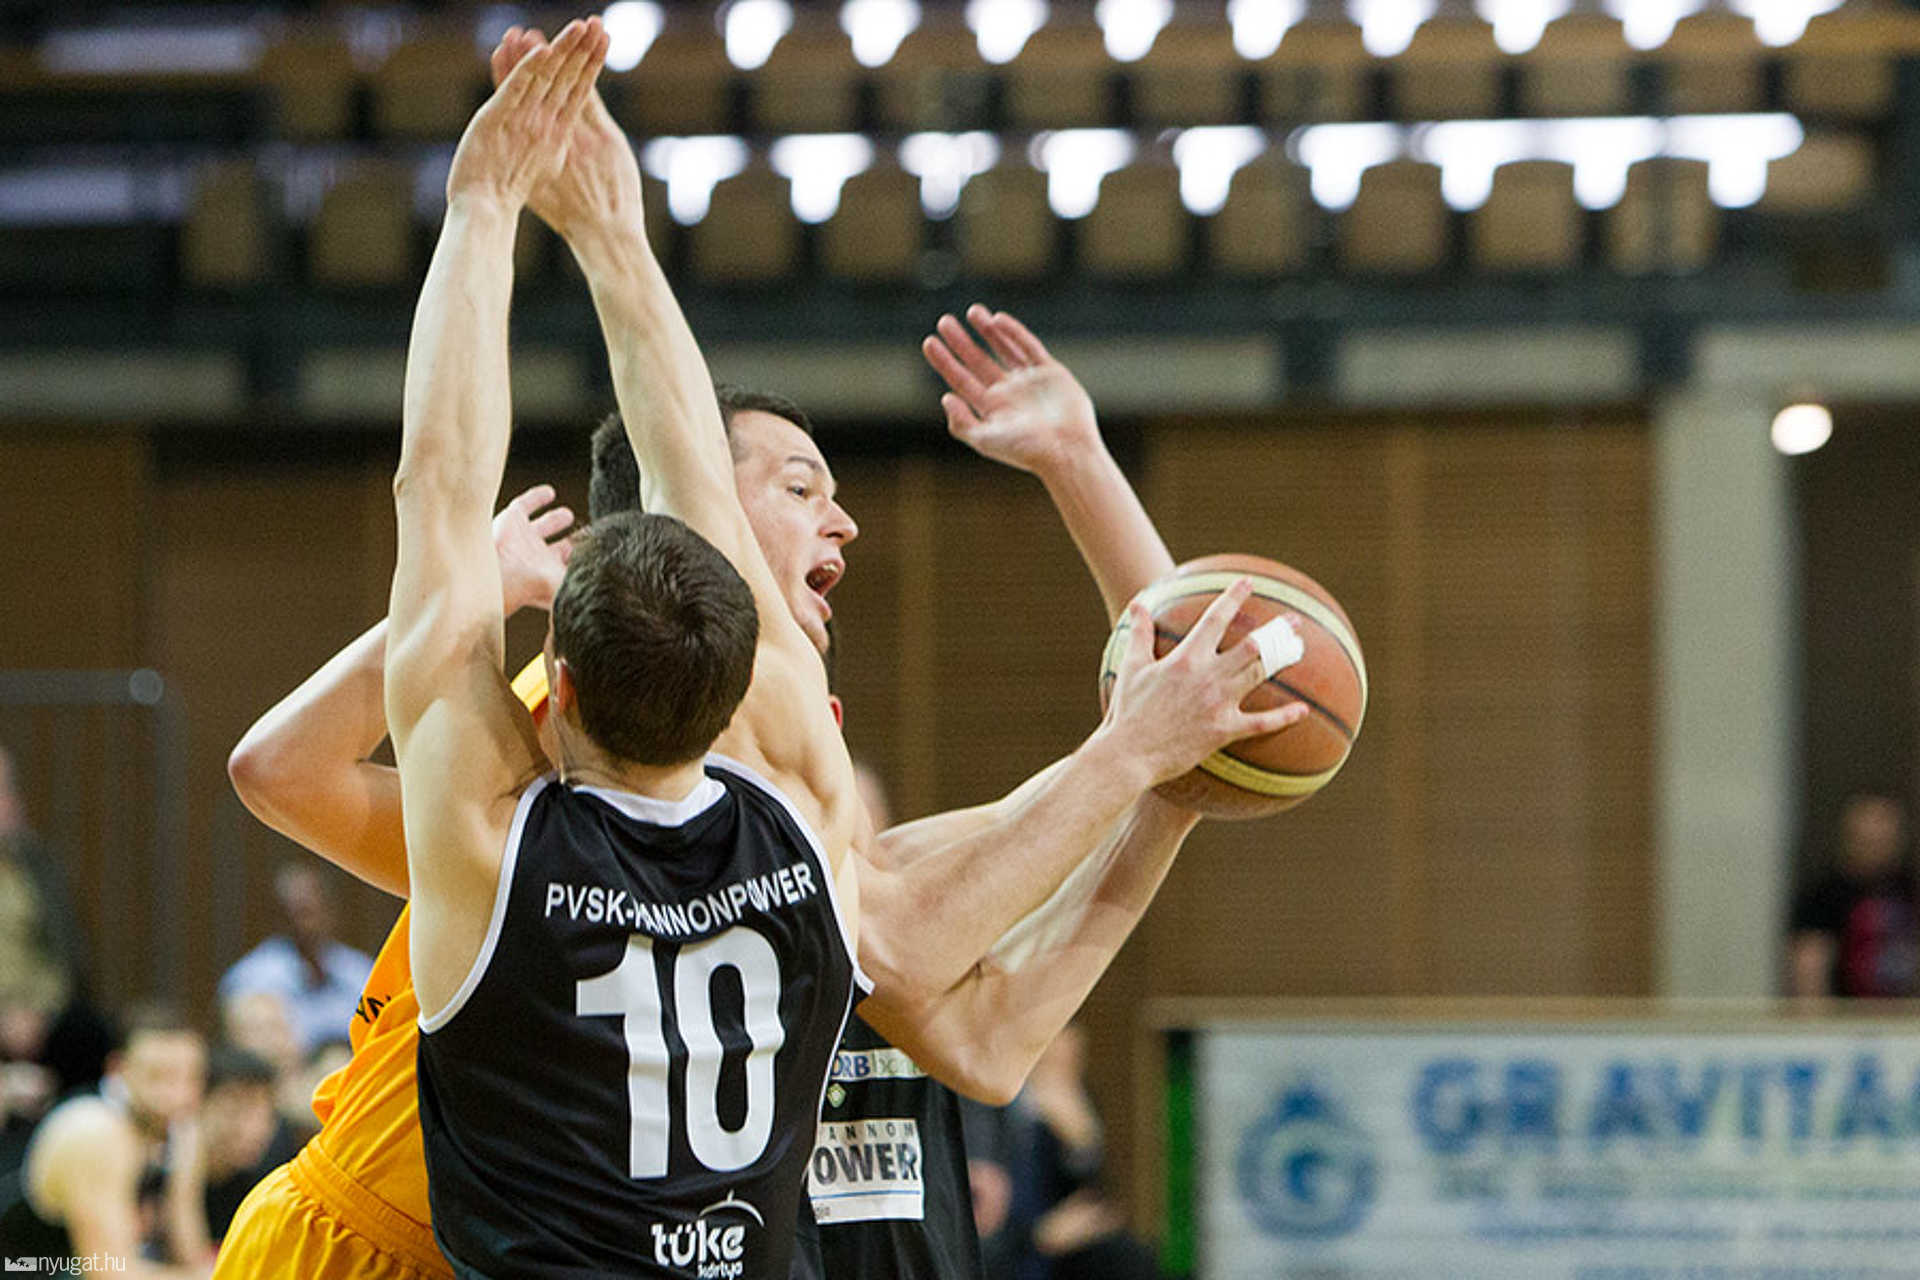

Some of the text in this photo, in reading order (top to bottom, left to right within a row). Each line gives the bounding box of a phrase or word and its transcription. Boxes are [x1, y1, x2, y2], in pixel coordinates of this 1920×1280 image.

[545, 862, 817, 936] PVSK-ANNONPOWER
[576, 926, 785, 1179] 10
[828, 1121, 916, 1141] ANNON
[1410, 1055, 1920, 1154] GRAVITA
[813, 1143, 918, 1186] OWER
[651, 1219, 745, 1267] tüke
